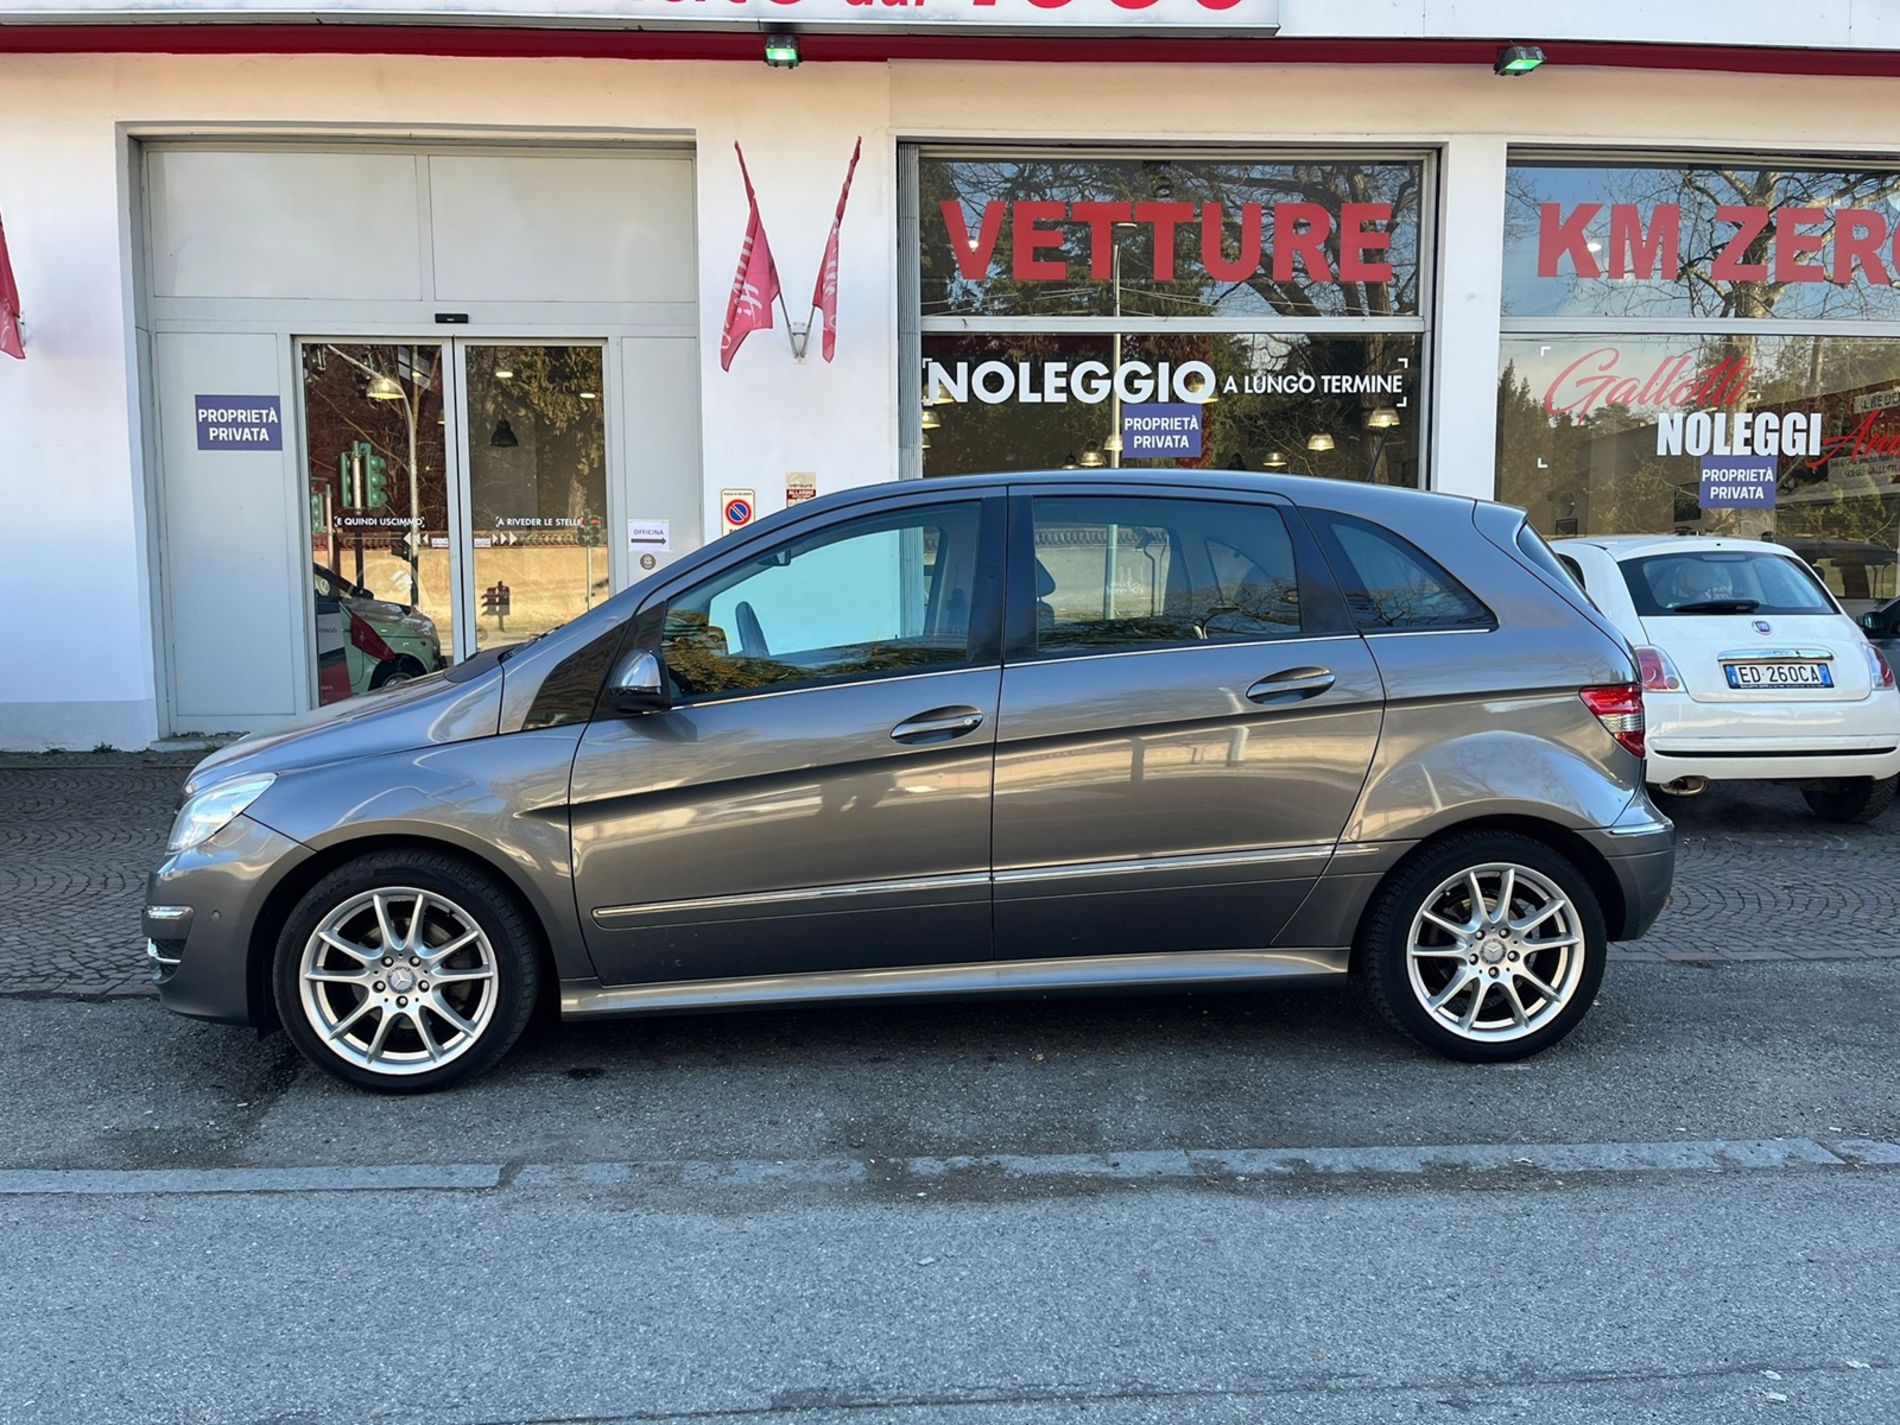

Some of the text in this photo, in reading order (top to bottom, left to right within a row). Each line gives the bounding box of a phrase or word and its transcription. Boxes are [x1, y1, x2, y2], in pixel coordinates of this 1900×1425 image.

[941, 200, 1392, 282] VETTURE
[1537, 202, 1900, 286] KM ZER
[928, 361, 1402, 404] NOLEGGIO A LUNGO TERMINE
[1544, 347, 1750, 424] Gallotti
[198, 407, 278, 423] PROPRIETÀ
[1125, 414, 1199, 431] PROPRIETÀ
[209, 427, 269, 441] PRIVATA
[1133, 435, 1190, 448] PRIVATA
[1657, 412, 1822, 456] NOLEGGI
[1702, 467, 1774, 482] PROPRIETÀ
[1710, 486, 1764, 499] PRIVATA
[344, 517, 377, 526] QUINDI
[497, 518, 505, 526] A
[506, 518, 541, 526] RIVEDER
[544, 518, 553, 526] LE
[1738, 666, 1820, 683] ED 260CA
